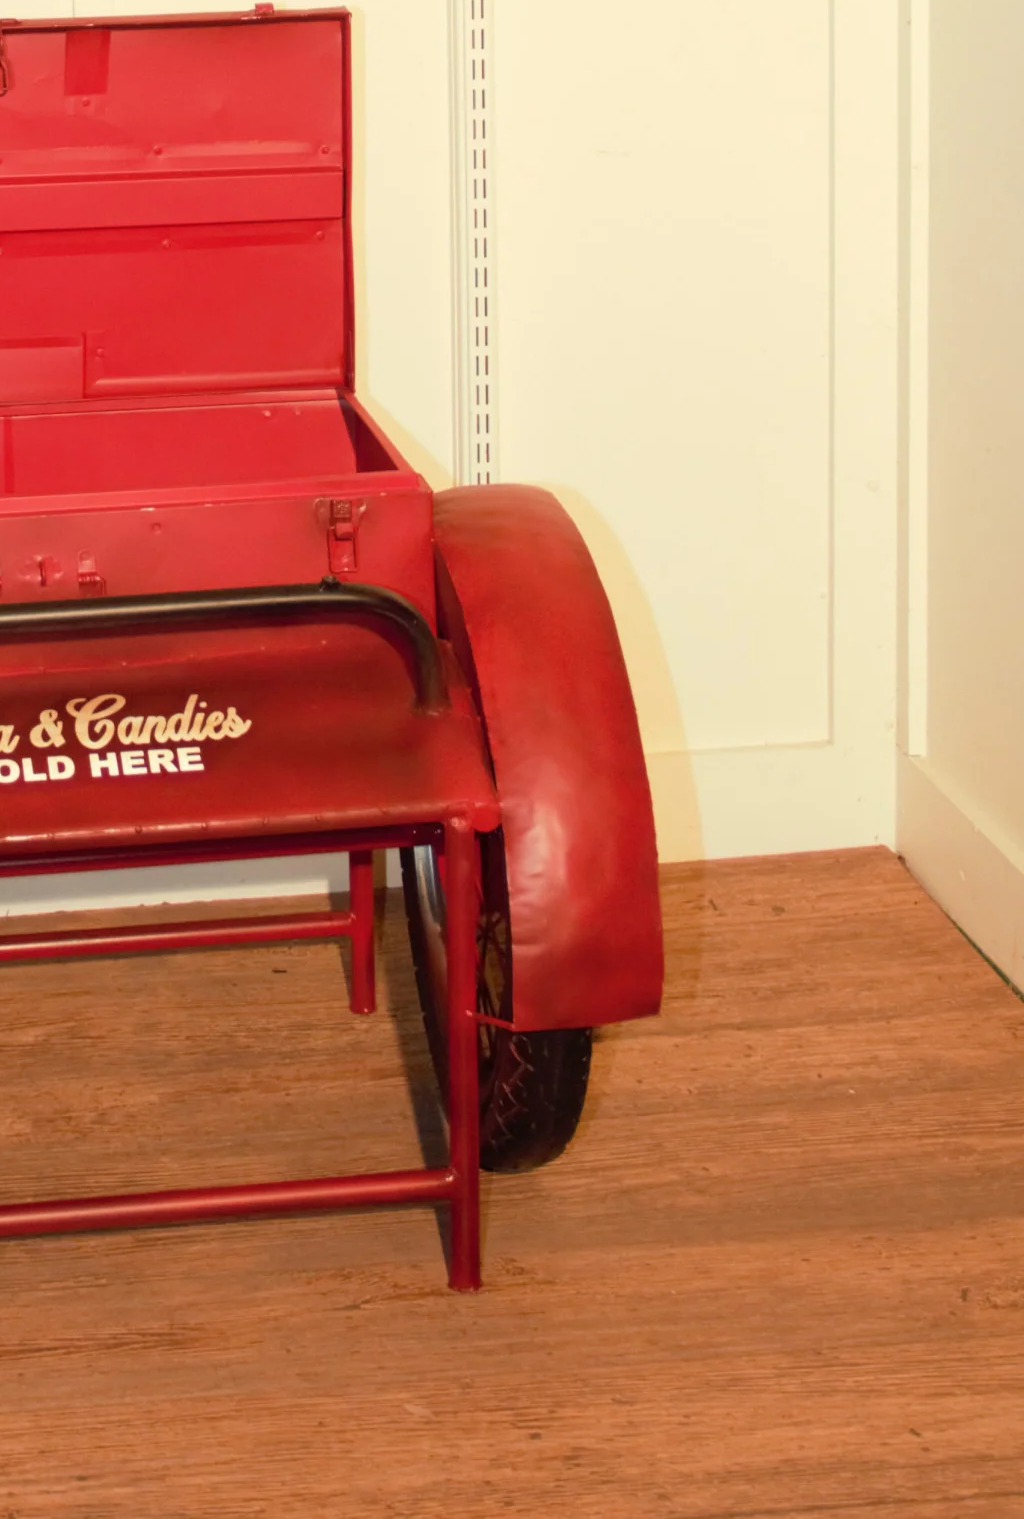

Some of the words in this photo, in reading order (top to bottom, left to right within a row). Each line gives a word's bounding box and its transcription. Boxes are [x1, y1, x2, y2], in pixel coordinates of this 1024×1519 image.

[28, 708, 64, 749] &
[65, 693, 253, 751] Candies
[89, 746, 206, 778] HERE
